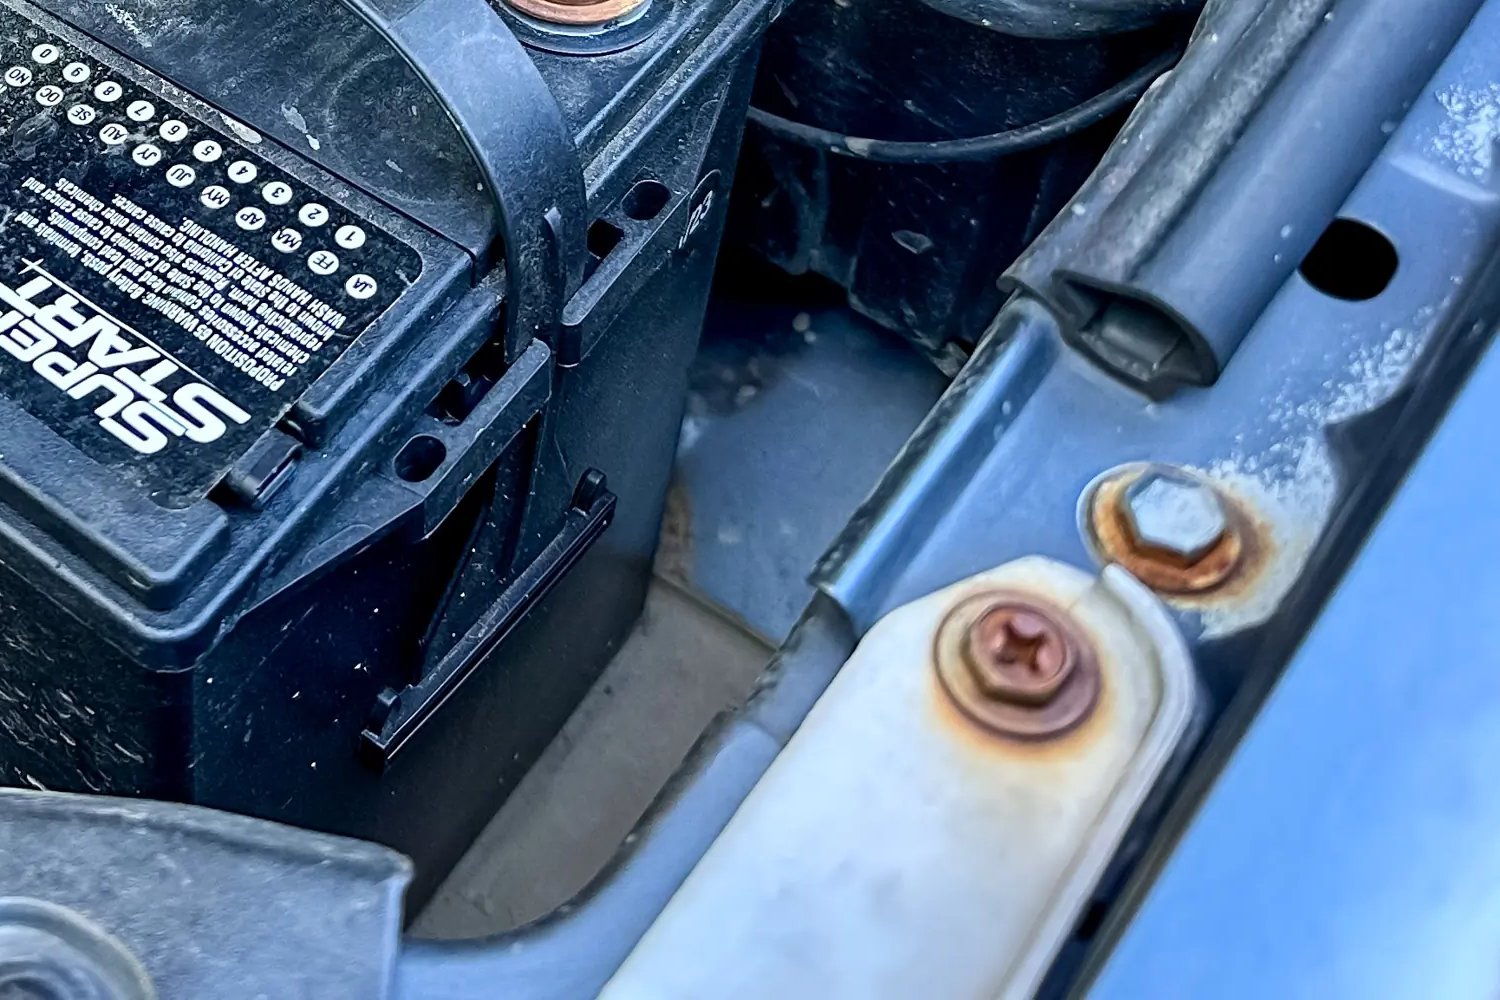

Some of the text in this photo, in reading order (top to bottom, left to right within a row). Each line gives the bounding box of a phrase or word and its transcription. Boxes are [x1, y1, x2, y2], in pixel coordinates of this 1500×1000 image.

[8, 68, 30, 84] NO
[39, 87, 60, 103] OC
[71, 107, 92, 121] SE
[103, 126, 126, 141] AU
[136, 148, 158, 161] JY
[21, 176, 46, 194] and
[170, 168, 192, 182] JU
[41, 188, 76, 213] cancer
[55, 177, 105, 212] chemicals
[204, 188, 229, 205] MY
[112, 193, 147, 220] cancer.
[14, 211, 39, 229] and
[71, 208, 104, 231] cause
[101, 207, 130, 228] other
[143, 214, 176, 238] cause
[240, 212, 263, 225] AP
[34, 222, 82, 258] terminals
[99, 225, 115, 240] to
[125, 222, 165, 250] contain
[171, 232, 187, 247] to
[97, 244, 125, 266] lead
[160, 244, 186, 264] also
[312, 253, 335, 270] FE
[119, 258, 145, 277] and
[153, 260, 171, 274] of
[179, 217, 346, 329] WASH HANDS AFTER HANDLING.
[226, 266, 245, 280] of
[138, 270, 167, 293] lead
[166, 268, 196, 292] State
[192, 280, 214, 299] the
[240, 275, 271, 298] State
[352, 277, 373, 293] JA
[209, 293, 225, 309] to
[228, 284, 260, 311] harm.
[267, 290, 290, 310] the
[220, 302, 259, 332] known
[285, 302, 301, 318] to
[193, 324, 213, 341] 65
[198, 305, 260, 352] accessories
[256, 303, 323, 351] reproductive
[297, 310, 335, 341] known
[254, 324, 310, 364] chemicals
[206, 334, 285, 391] PROPOSITION
[254, 347, 297, 377] related
